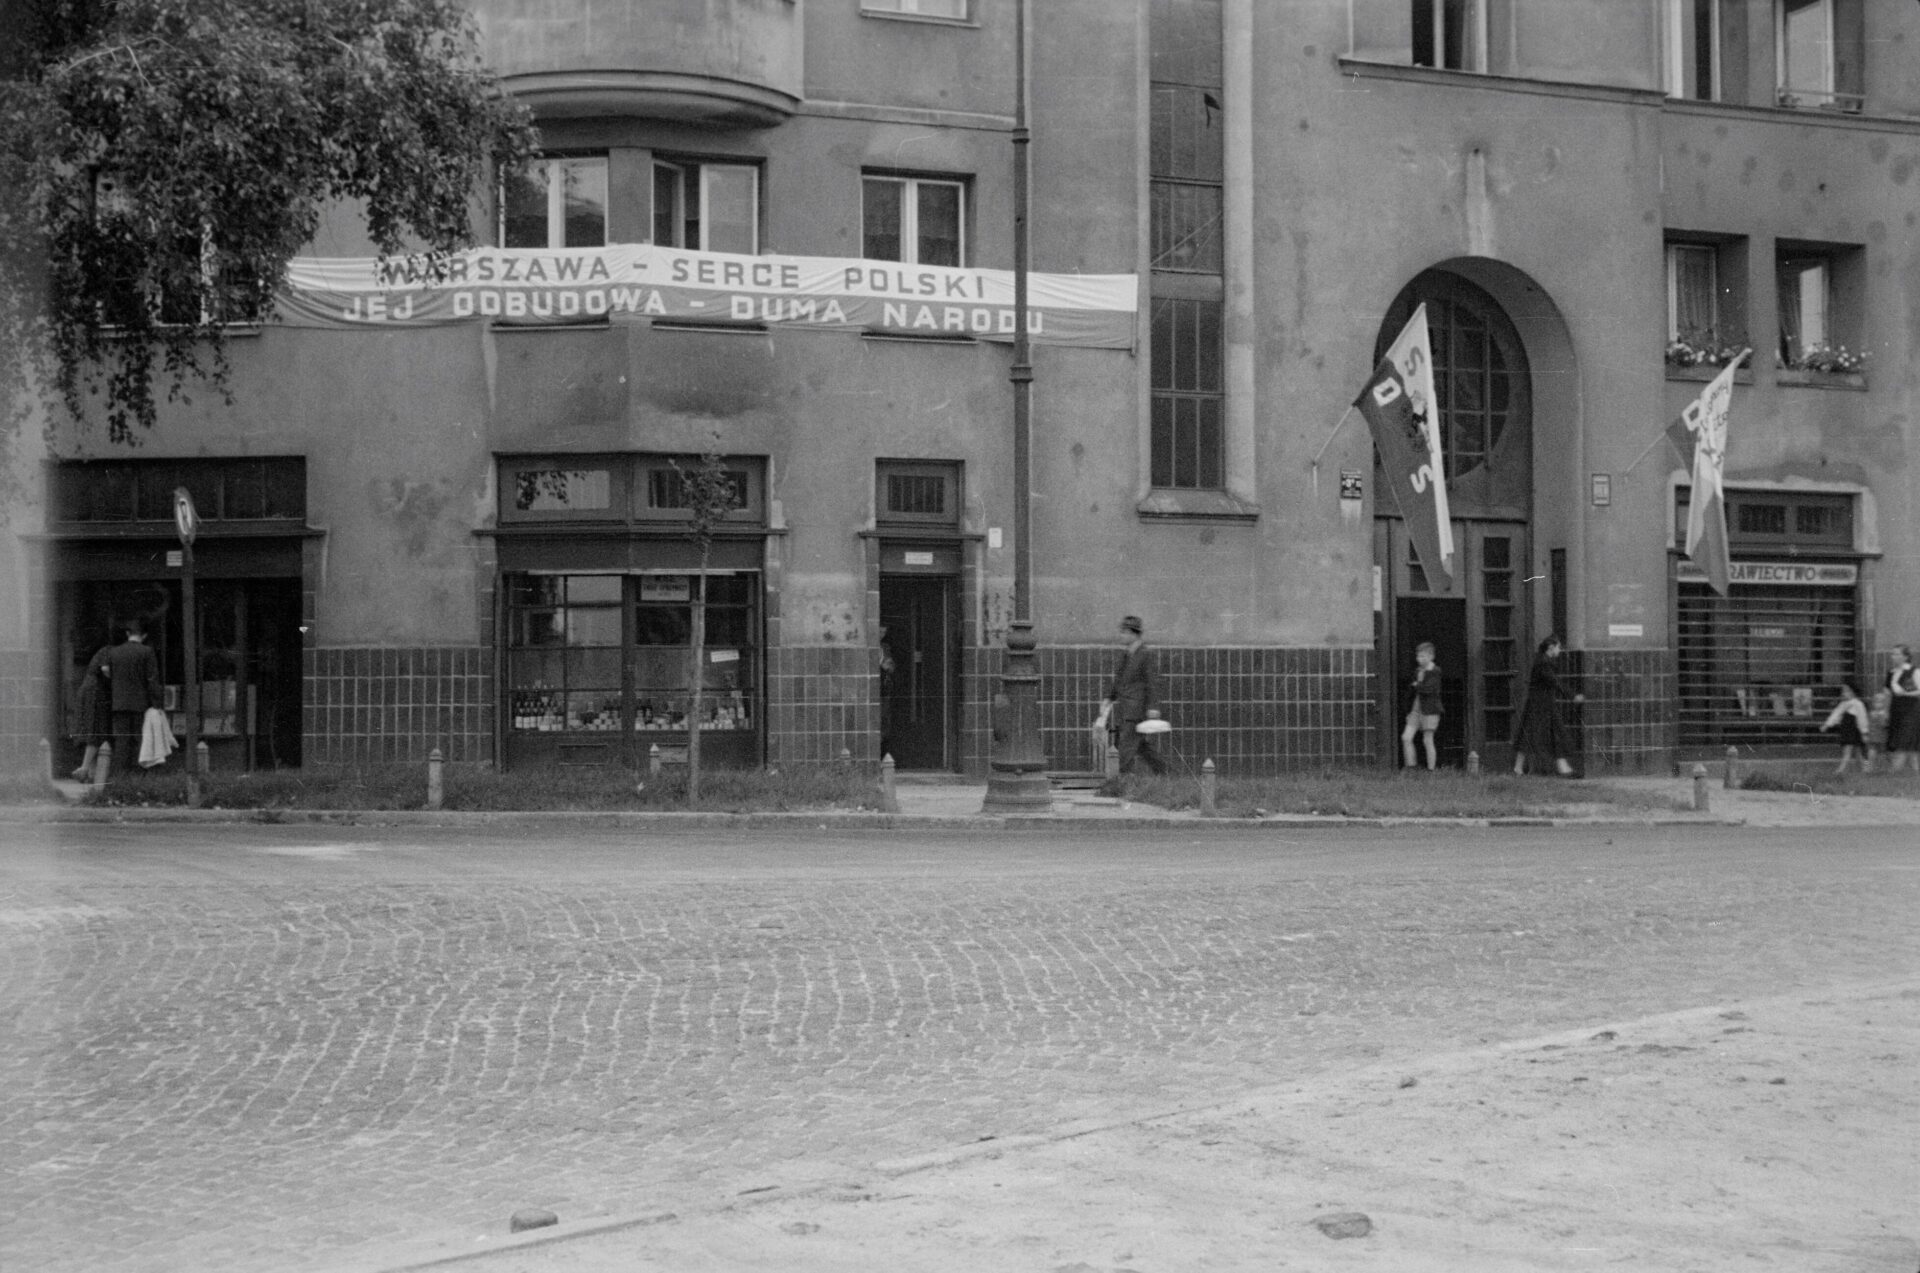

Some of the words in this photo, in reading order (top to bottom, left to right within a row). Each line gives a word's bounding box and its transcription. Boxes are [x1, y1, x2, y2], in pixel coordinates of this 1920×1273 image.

[382, 255, 612, 287] WARSZAWA
[671, 258, 799, 289] SERCE
[844, 267, 984, 299] POLSKI
[343, 294, 413, 321] JEJ
[452, 288, 668, 317] ODBUDOWA
[731, 295, 848, 324] DUMA
[883, 302, 1043, 334] NARODU
[1729, 564, 1817, 582] RAWIECTWO
